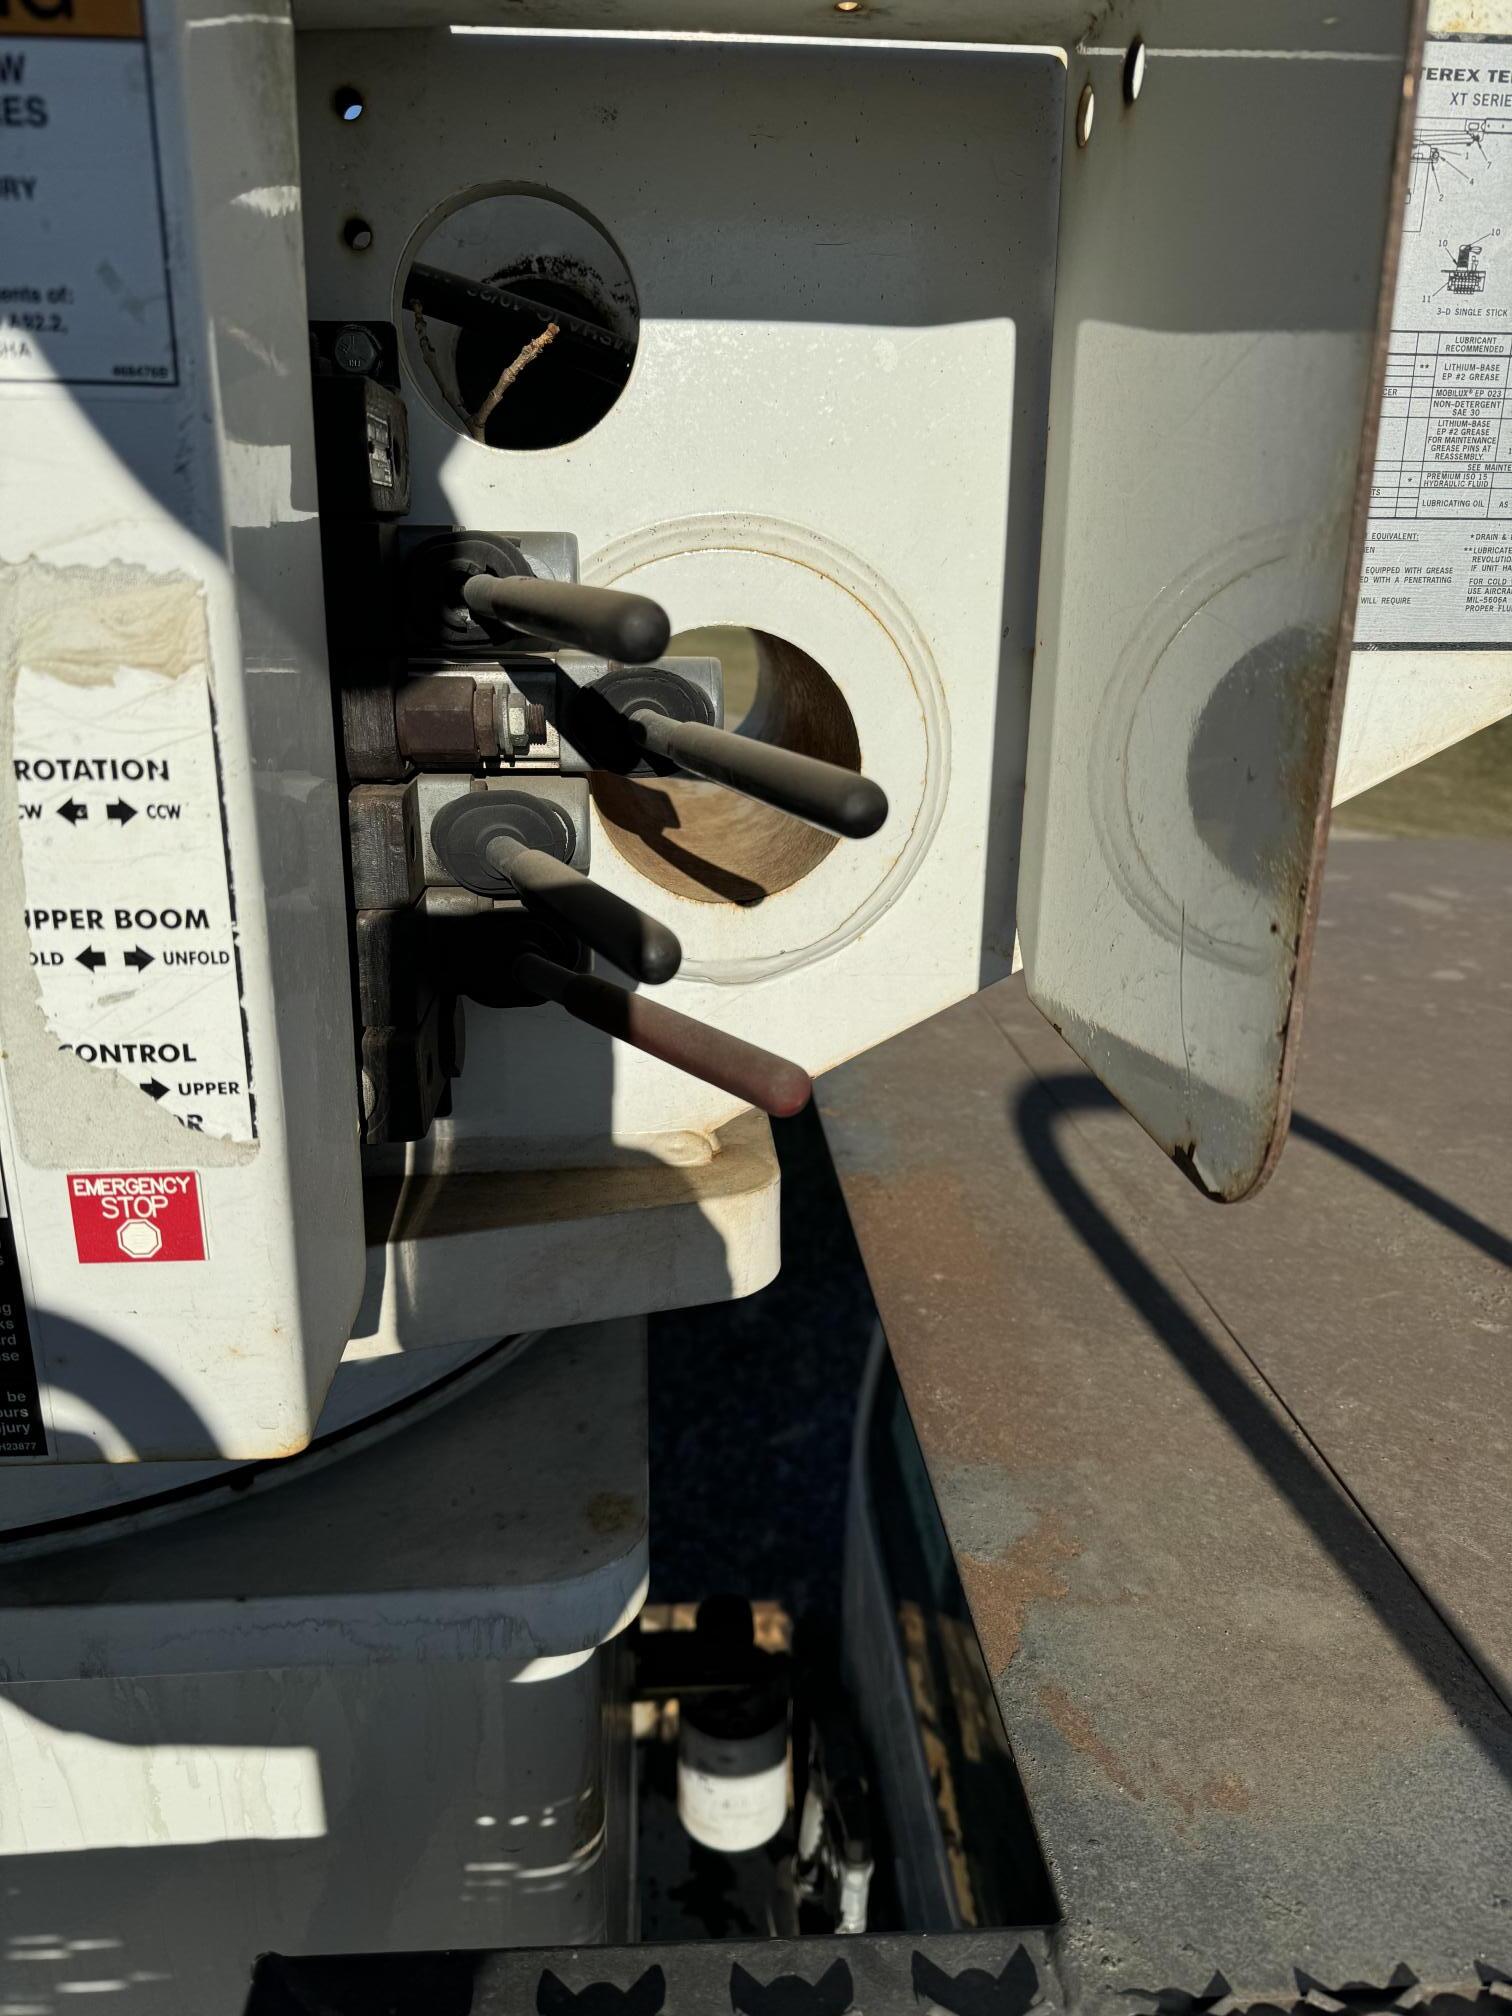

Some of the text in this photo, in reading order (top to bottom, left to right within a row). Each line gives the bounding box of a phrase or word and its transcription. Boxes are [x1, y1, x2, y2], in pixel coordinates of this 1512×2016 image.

[1450, 92, 1468, 106] XT
[1469, 178, 1475, 186] 4
[1438, 193, 1444, 202] 2
[1491, 228, 1501, 236] 10
[1438, 239, 1448, 247] 10
[1422, 295, 1431, 303] 11
[1436, 307, 1508, 317] 3-D SINGLE STICK
[1455, 336, 1498, 345] LUBRICANT
[1445, 344, 1504, 353] RECOMMENDED
[1444, 363, 1500, 371] LITHIUM-BASE
[1442, 372, 1452, 380] EP
[1469, 373, 1500, 381] GREASE
[1487, 390, 1502, 398] 023
[1433, 400, 1501, 409] NON-DETERGENT
[1437, 420, 1491, 428] LITHIUM-BASE
[1436, 428, 1490, 436] EP #2 GREASE
[1427, 436, 1497, 445] FOR MAINTENANCE
[1430, 444, 1460, 452] GREASE
[1482, 445, 1491, 453] AT
[1467, 463, 1481, 471] SEE
[1423, 480, 1489, 488] HYDRAULIC FLUID
[1421, 500, 1509, 509] LUBRICATING OIL AS
[1371, 532, 1419, 540] EQUIVALENT:
[1365, 566, 1401, 574] EQUIPPED
[1404, 566, 1422, 574] WITH
[1470, 564, 1478, 572] IF
[1481, 564, 1499, 572] UNIT
[1373, 576, 1391, 584] WITH
[1404, 576, 1452, 584] PENETRATING
[1467, 587, 1482, 595] USE
[1360, 597, 1412, 605] WILL REQUIRE
[1465, 596, 1507, 604] MIL-5606A
[1465, 604, 1494, 612] PROPER
[13, 759, 169, 781] ROTATION
[146, 803, 182, 820] CCW
[114, 908, 209, 929] BOOM
[162, 951, 230, 965] UNFOLD
[178, 1081, 240, 1096] UPPER
[73, 1176, 190, 1197] EMERGENCY
[101, 1195, 168, 1219] STOP
[7, 1390, 26, 1402] be
